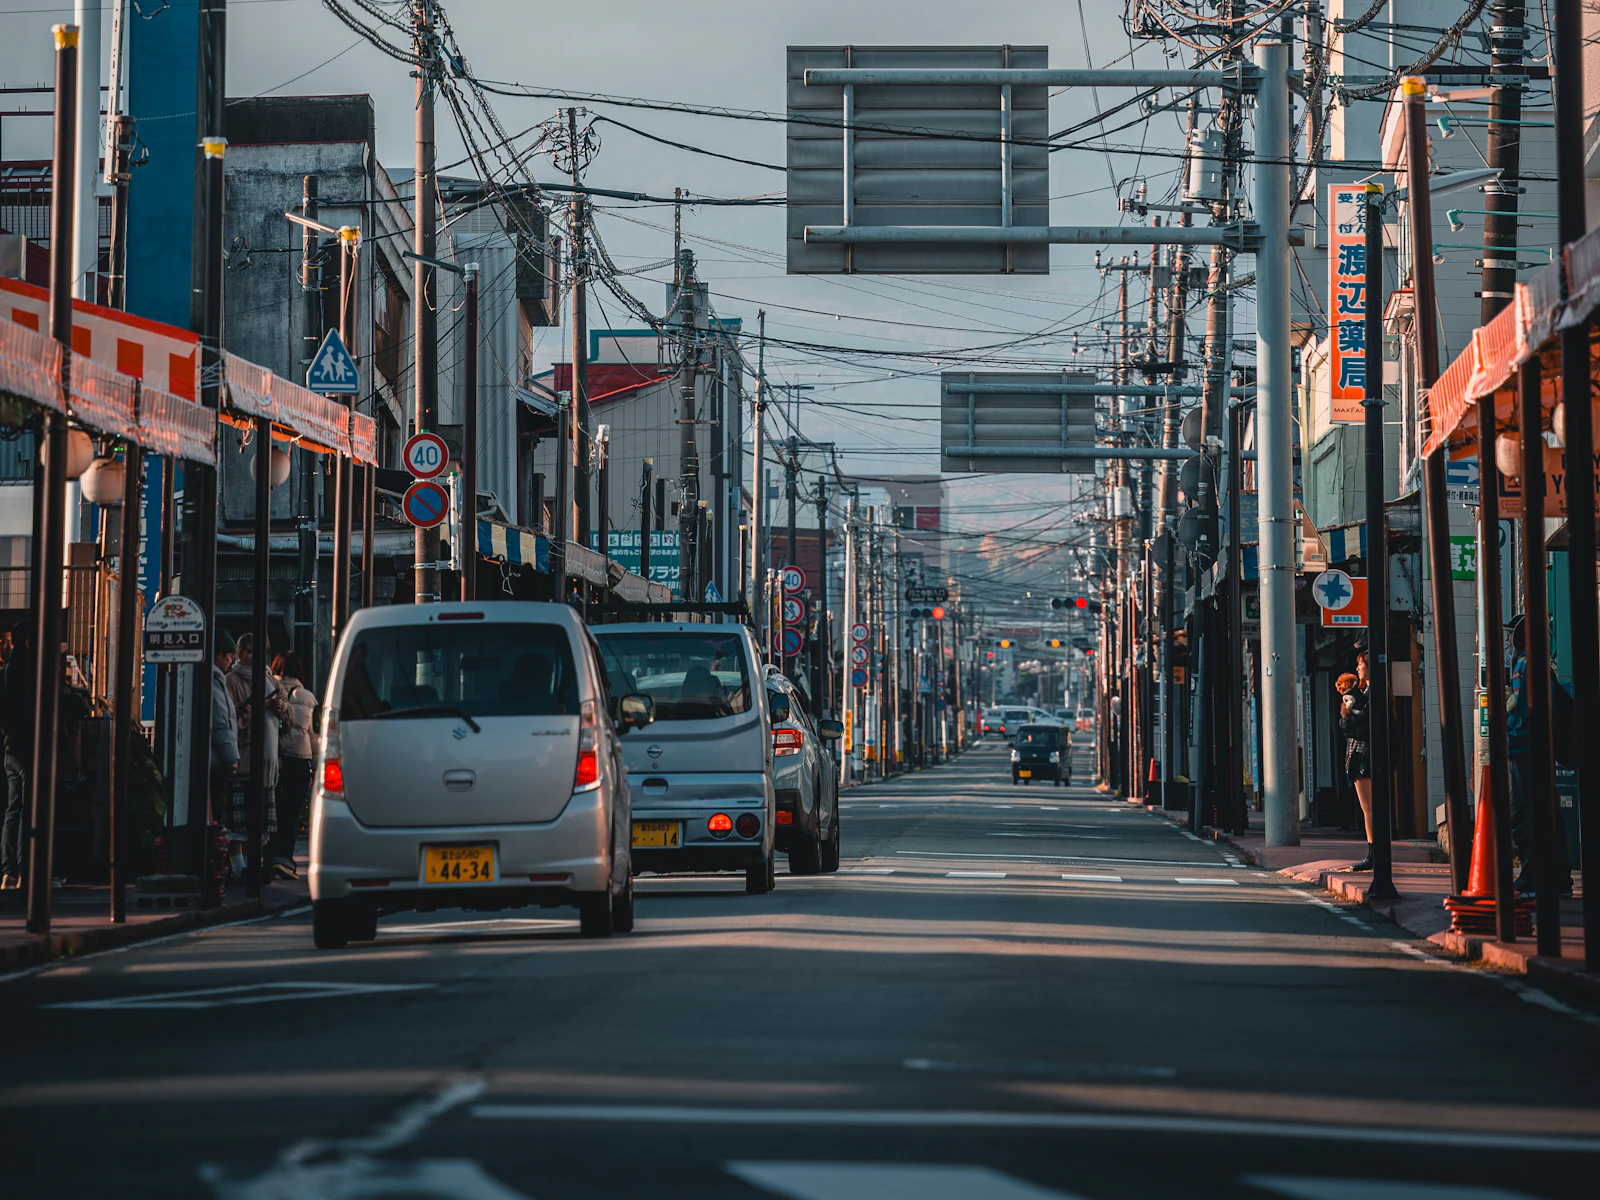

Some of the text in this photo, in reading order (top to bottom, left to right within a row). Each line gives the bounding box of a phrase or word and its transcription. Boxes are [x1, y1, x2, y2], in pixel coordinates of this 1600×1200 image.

[1337, 243, 1366, 390] 渡辺薬局
[414, 446, 438, 466] 40
[784, 574, 800, 587] 40
[150, 633, 200, 644] 明見入口
[855, 629, 866, 638] 40
[440, 860, 490, 880] 44-34
